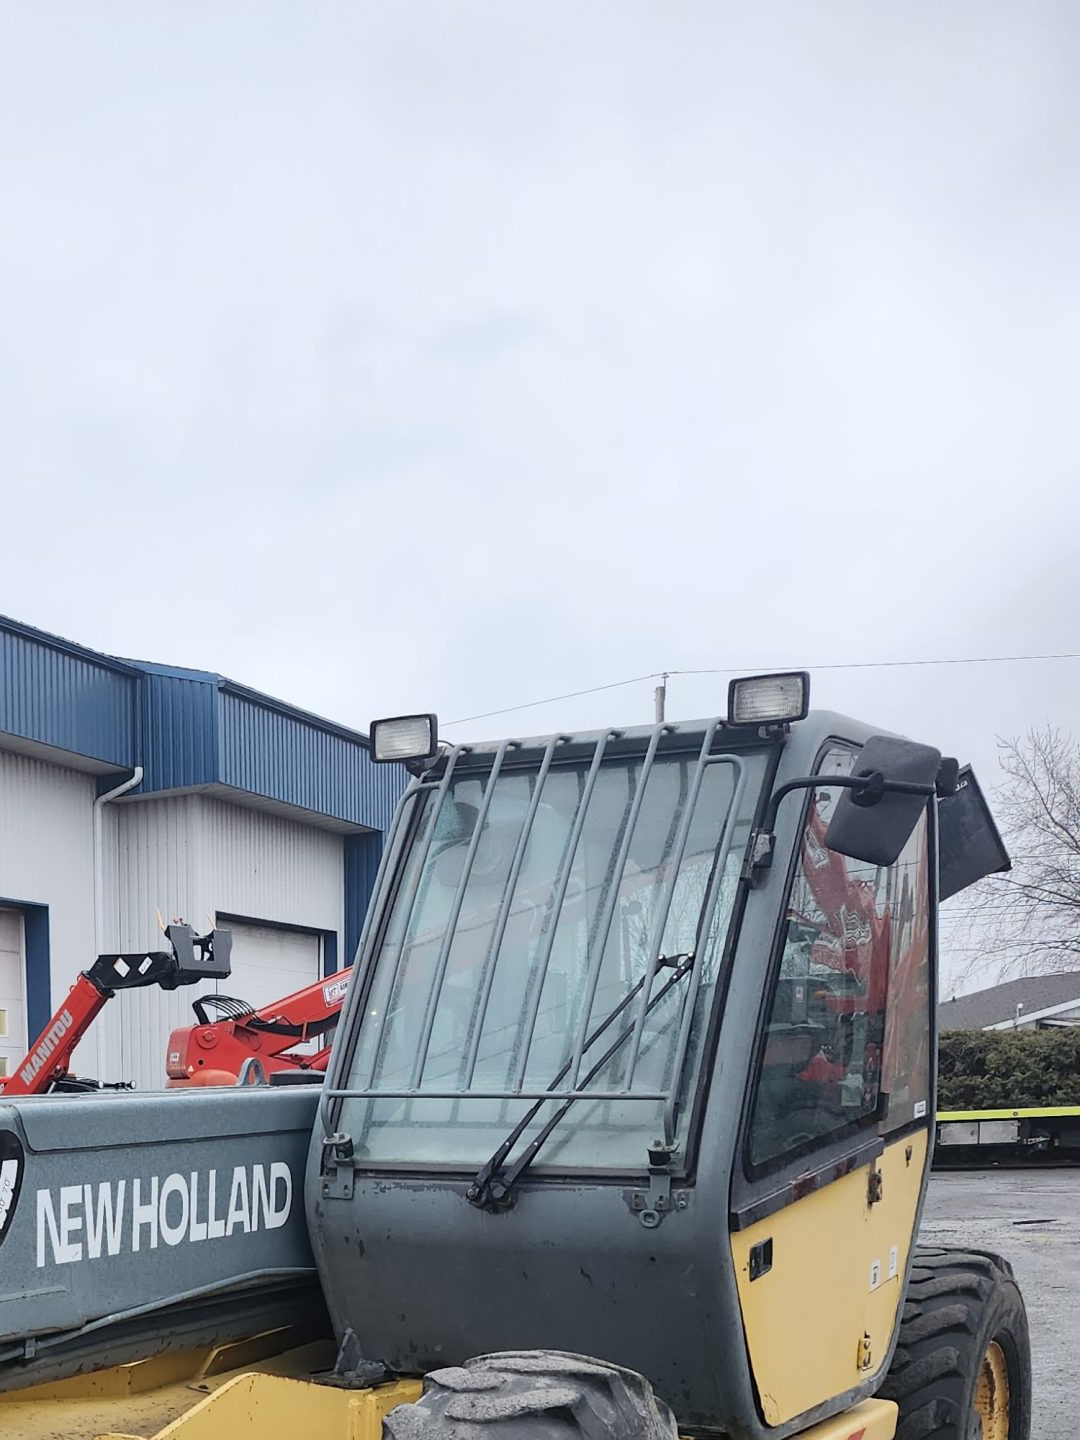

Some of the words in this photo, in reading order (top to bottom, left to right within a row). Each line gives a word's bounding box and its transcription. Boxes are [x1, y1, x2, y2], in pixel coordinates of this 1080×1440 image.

[20, 1008, 73, 1086] MANITOU
[36, 1179, 126, 1268] NEW
[132, 1161, 293, 1252] HOLLAND
